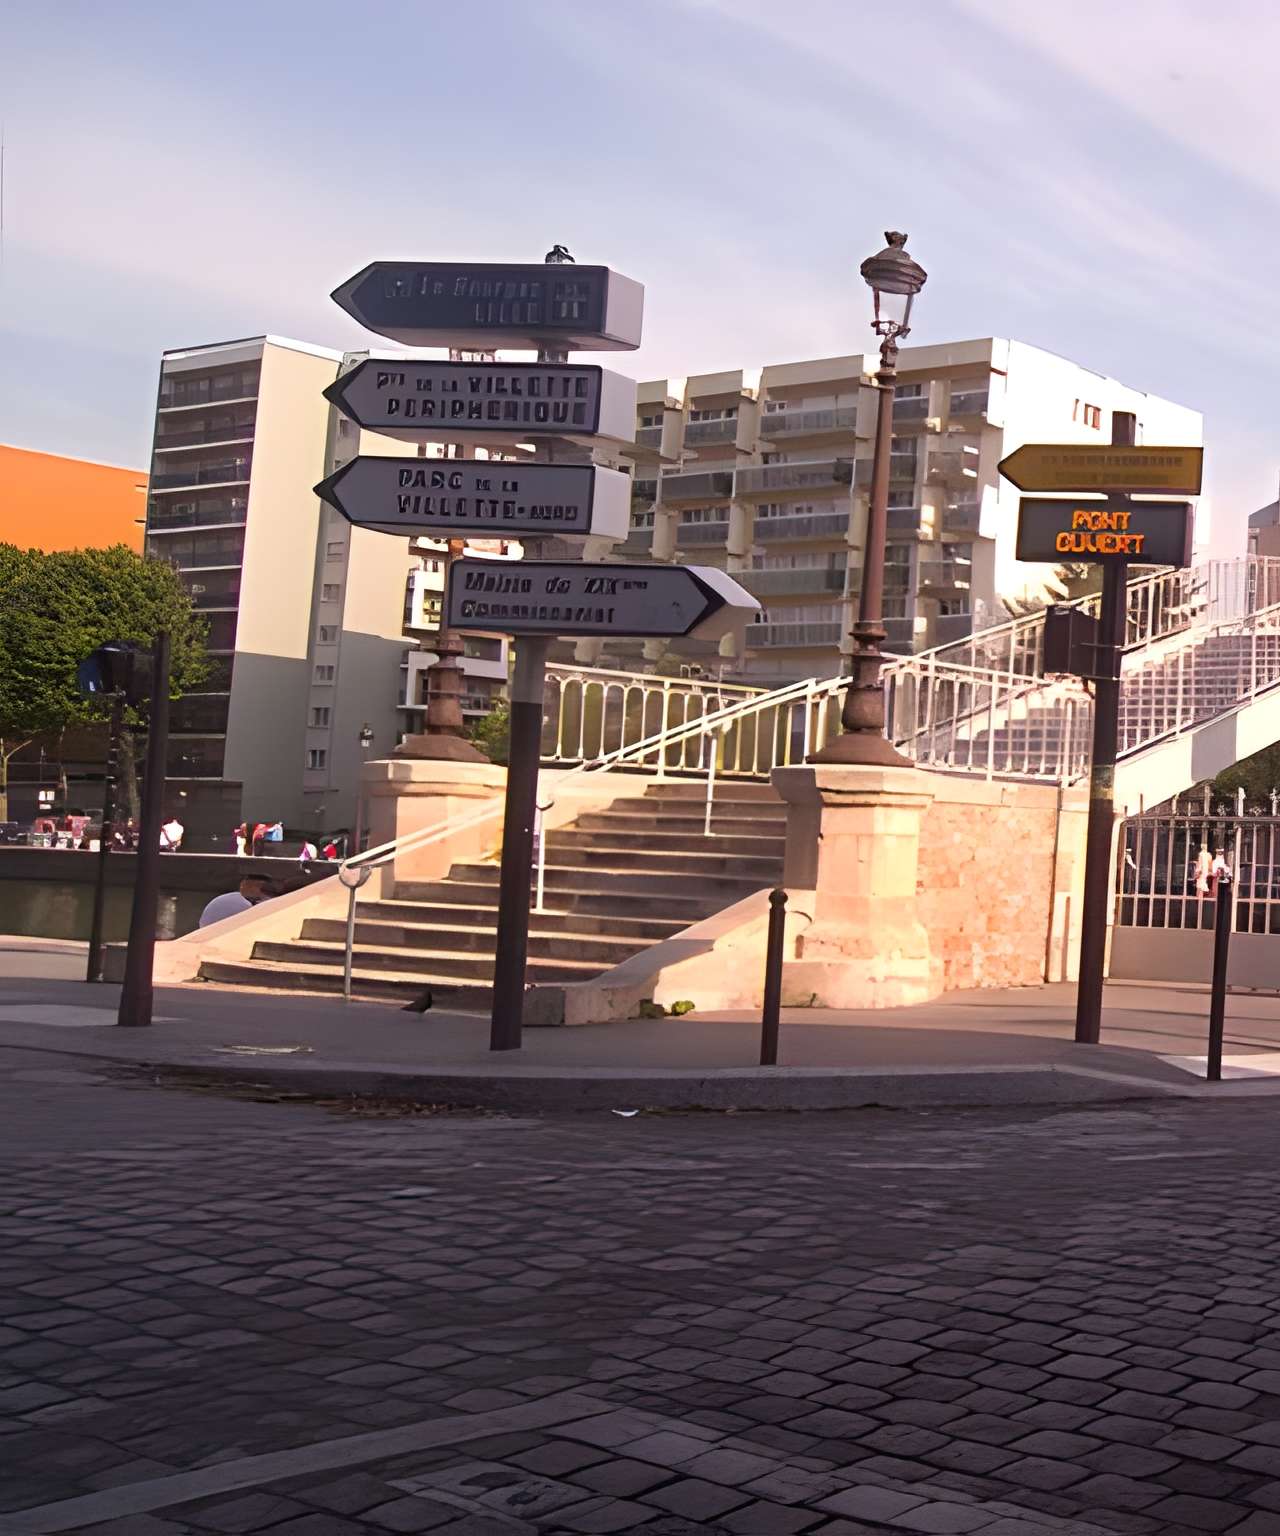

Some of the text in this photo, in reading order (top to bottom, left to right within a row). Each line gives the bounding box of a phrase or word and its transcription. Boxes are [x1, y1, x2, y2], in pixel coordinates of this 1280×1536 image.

[467, 376, 589, 398] VILLETTE
[399, 468, 463, 490] PARC
[1072, 510, 1132, 531] PONT
[1056, 531, 1145, 554] OUVERT
